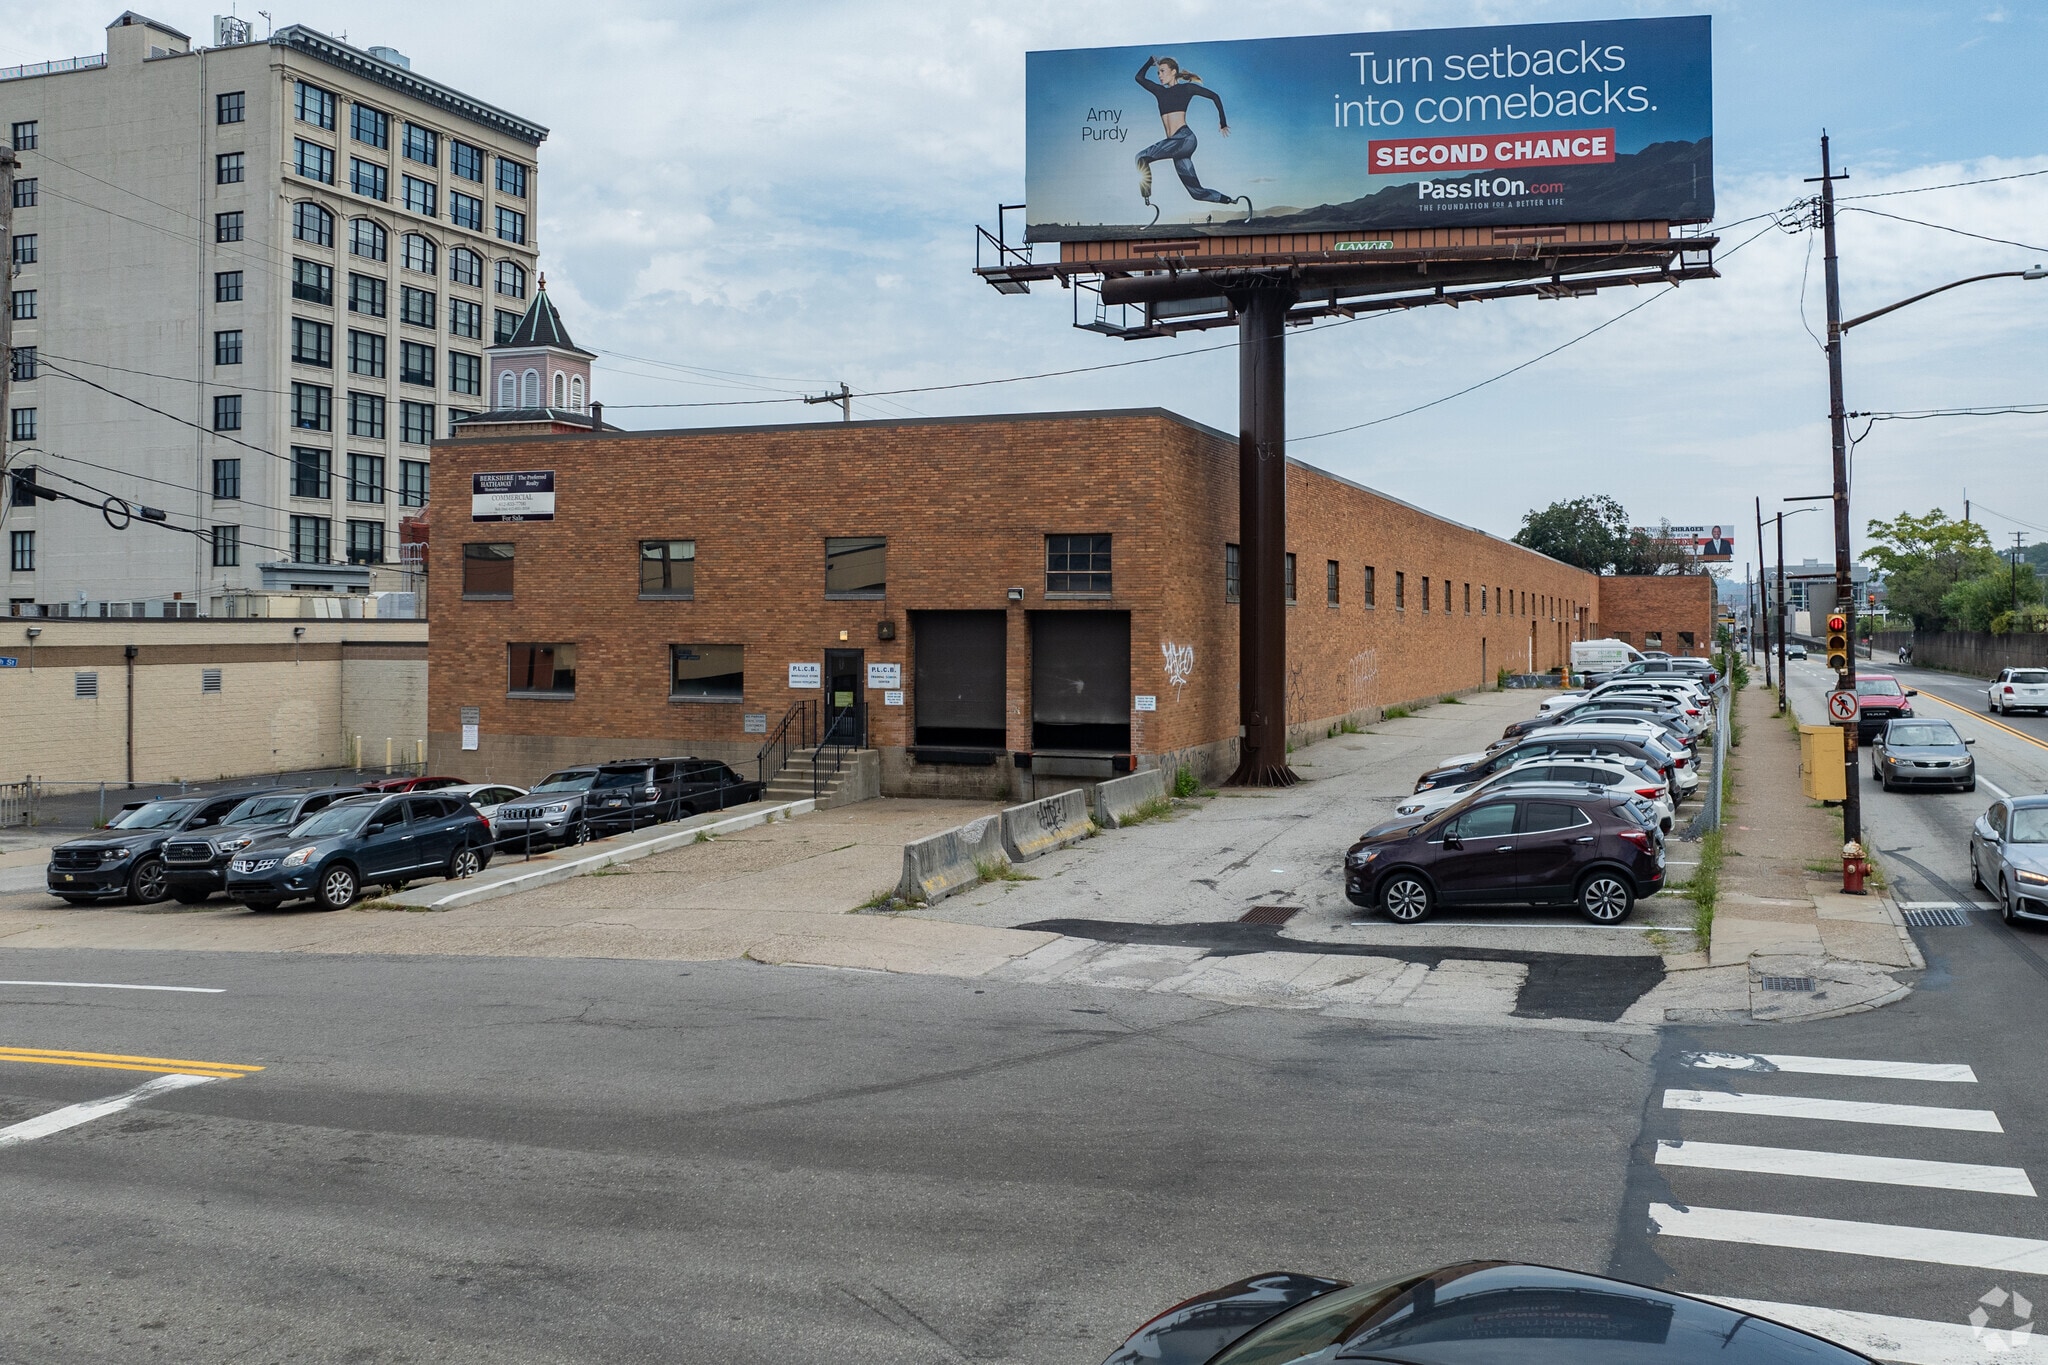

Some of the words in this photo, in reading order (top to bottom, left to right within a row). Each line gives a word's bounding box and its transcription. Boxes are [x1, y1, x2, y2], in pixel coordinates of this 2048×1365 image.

[1350, 51, 1433, 85] Turn
[1444, 40, 1626, 81] setbacks
[1334, 93, 1404, 128] into
[1415, 80, 1657, 125] comebacks.
[1086, 107, 1122, 124] Amy
[1082, 126, 1128, 143] Purdy
[1376, 143, 1488, 167] SECOND
[1494, 136, 1607, 162] CHANCE
[1419, 204, 1433, 212] THE
[1437, 202, 1489, 211] FOUNDATION
[1516, 199, 1544, 208] BETTER
[1547, 198, 1564, 206] LIFE
[1340, 242, 1388, 251] LAMAR
